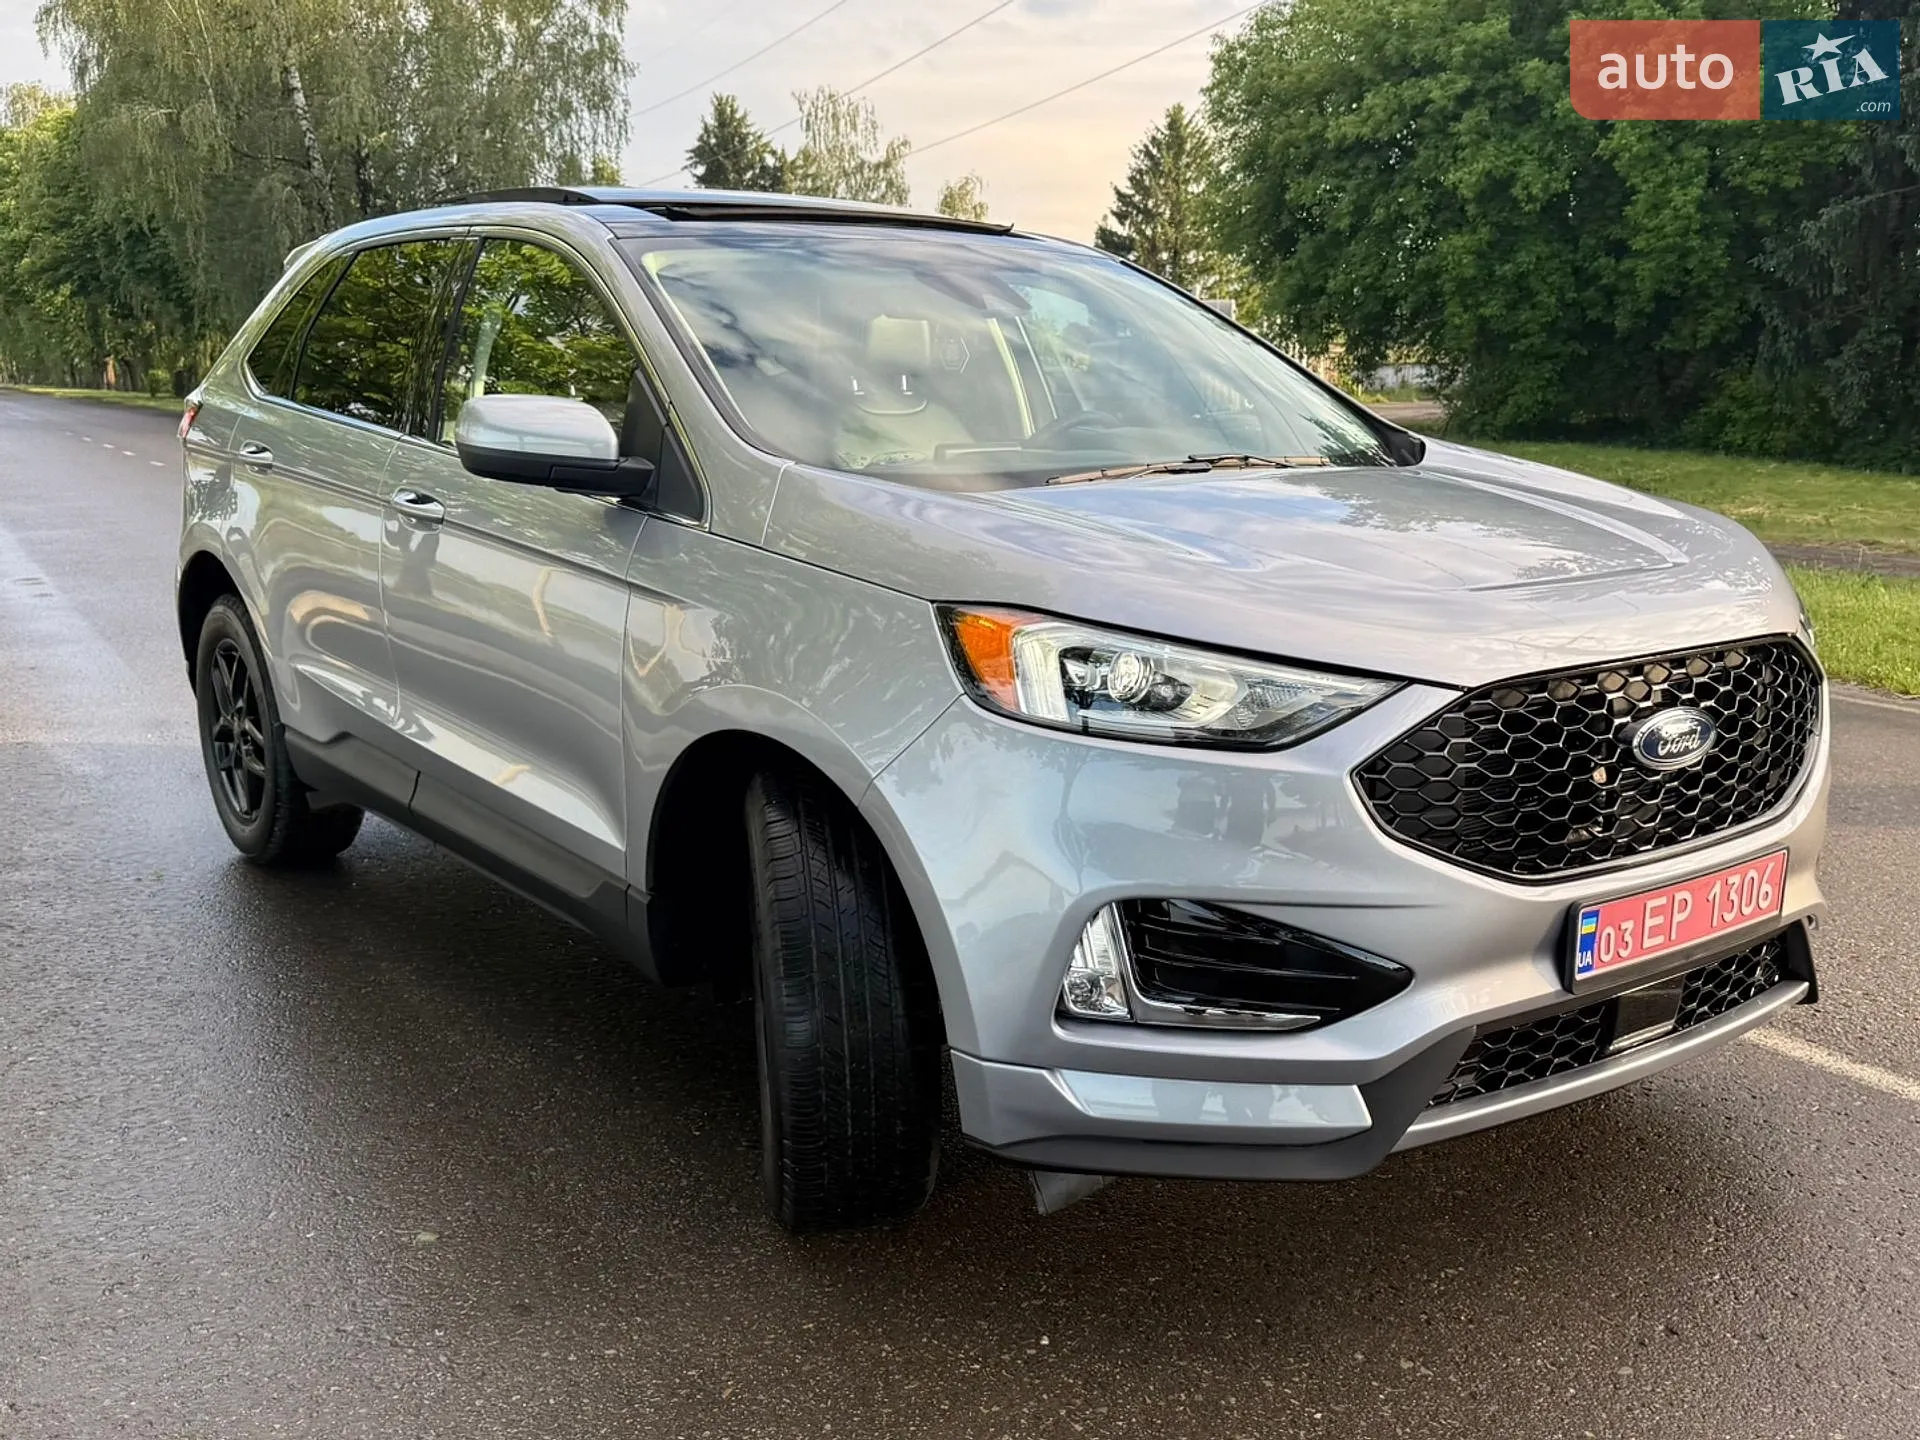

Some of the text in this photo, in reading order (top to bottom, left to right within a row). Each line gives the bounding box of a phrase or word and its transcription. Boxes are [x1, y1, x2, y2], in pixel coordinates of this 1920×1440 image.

[1655, 721, 1701, 757] Ford
[1600, 862, 1776, 963] 03 EP 1306
[1578, 950, 1593, 968] UA
